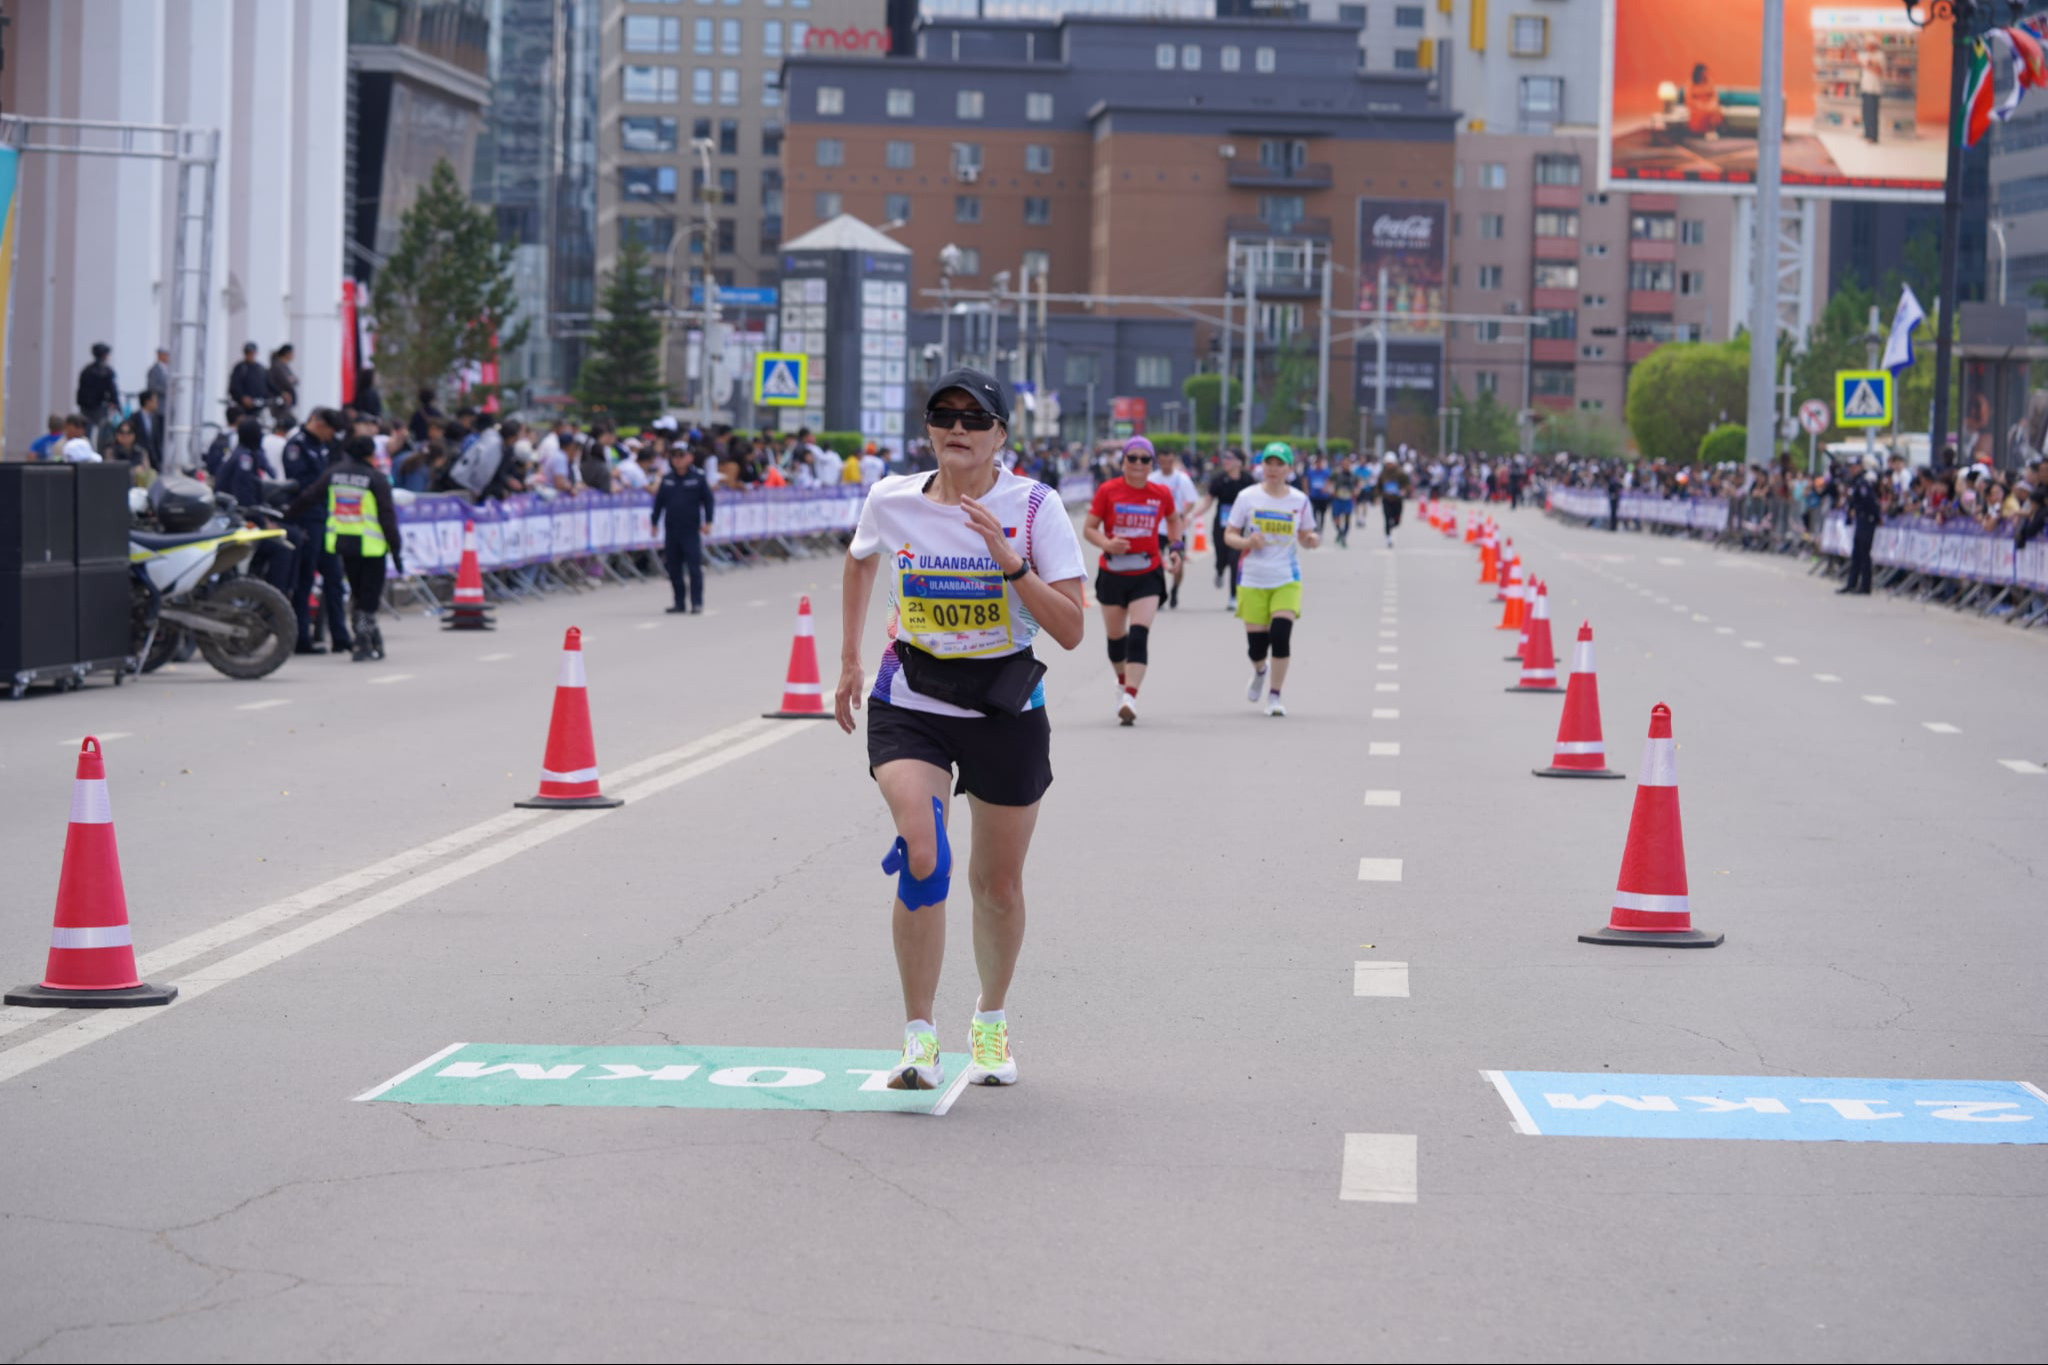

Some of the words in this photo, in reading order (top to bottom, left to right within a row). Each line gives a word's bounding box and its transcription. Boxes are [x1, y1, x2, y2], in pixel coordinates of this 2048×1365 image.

[919, 555, 1004, 571] ULAANBAATA
[929, 580, 985, 591] ULAANBAATAR
[908, 602, 926, 612] 21
[933, 603, 1001, 627] 00788
[1542, 1092, 2035, 1123] 21KM
